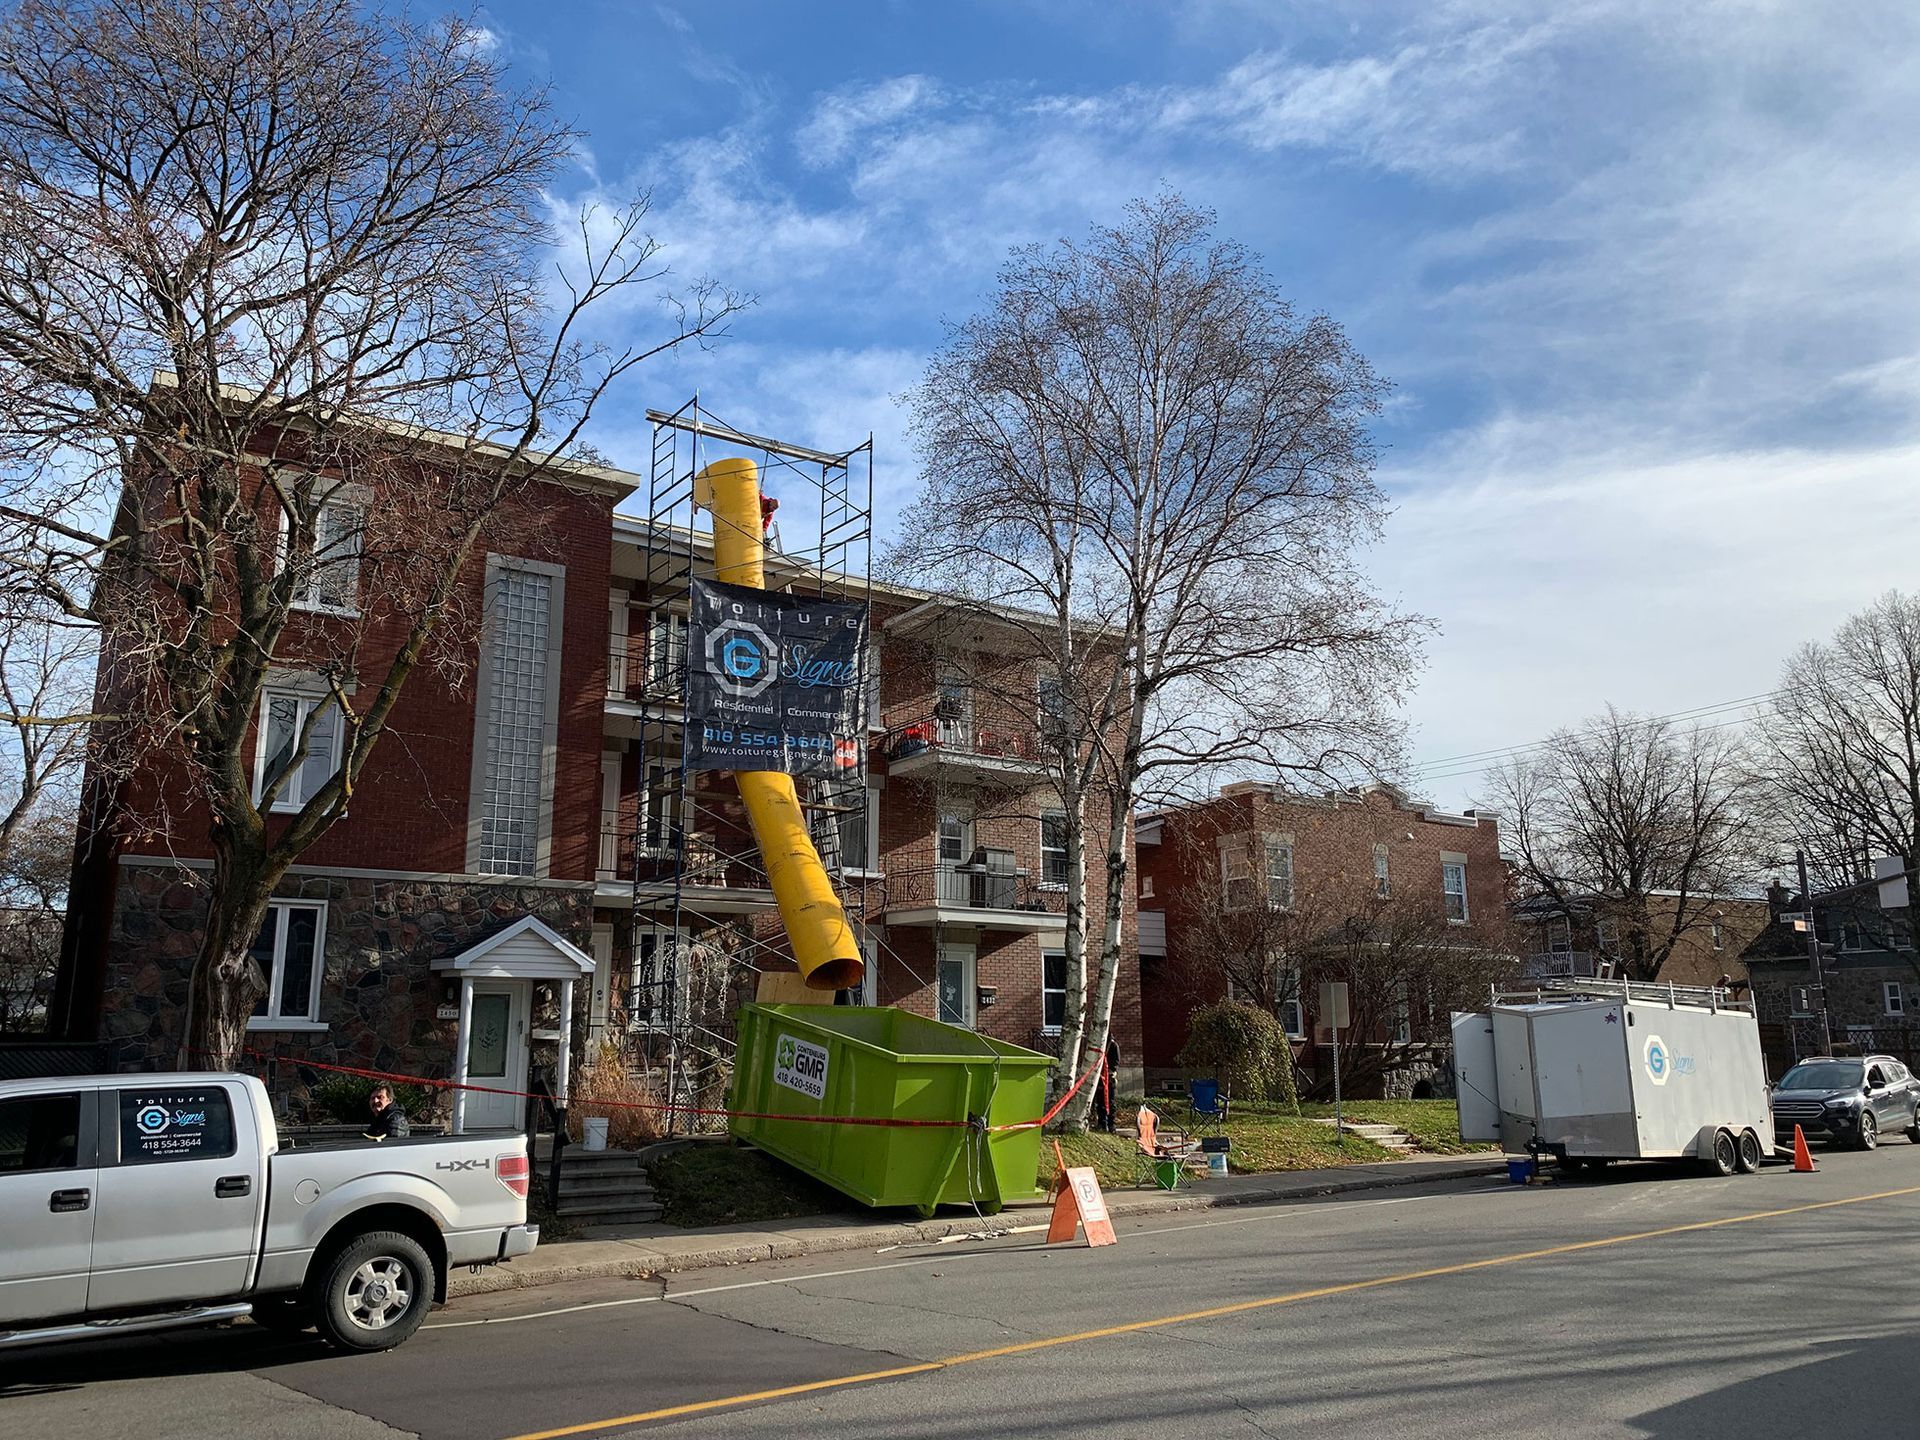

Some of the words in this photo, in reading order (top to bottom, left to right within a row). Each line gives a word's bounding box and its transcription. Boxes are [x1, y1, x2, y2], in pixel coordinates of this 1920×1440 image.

[705, 594, 858, 629] Toiture
[703, 728, 733, 743] 418
[740, 732, 832, 751] 554-3644
[777, 1071, 789, 1083] 418
[795, 1053, 825, 1082] GMR
[142, 1141, 159, 1149] 418
[161, 1138, 202, 1149] 554-3644
